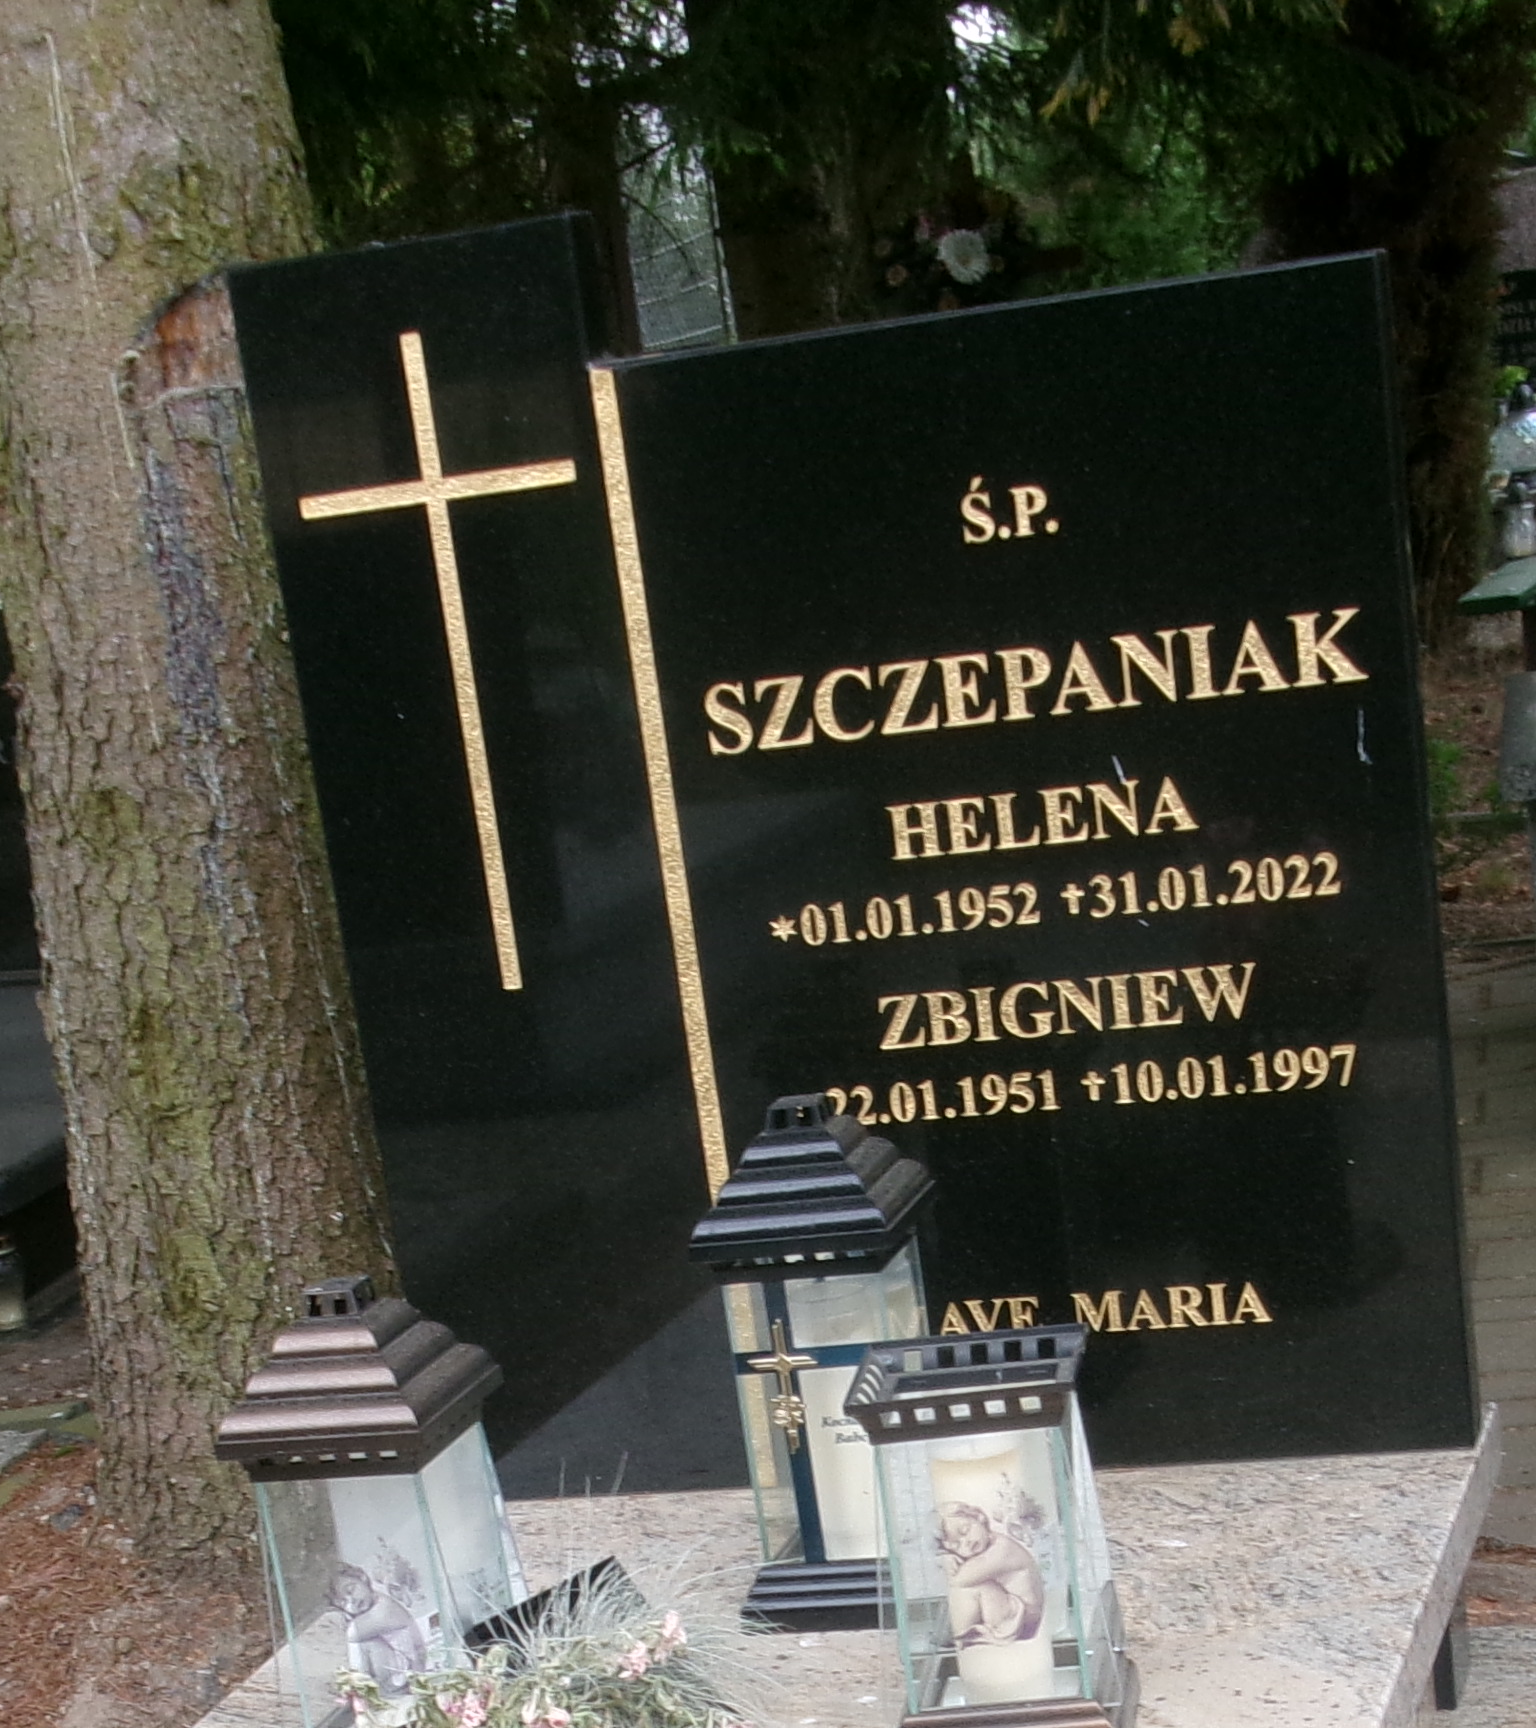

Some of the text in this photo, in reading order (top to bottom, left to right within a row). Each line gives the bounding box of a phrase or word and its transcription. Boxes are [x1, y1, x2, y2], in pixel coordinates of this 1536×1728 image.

[960, 477, 1060, 544] Ś.P.
[704, 607, 1368, 756] SZCZEPANIAK
[885, 775, 1199, 861] HELENA
[877, 961, 1256, 1051] ZBIGNIEW
[939, 1281, 1273, 1336] AVE MARIA
